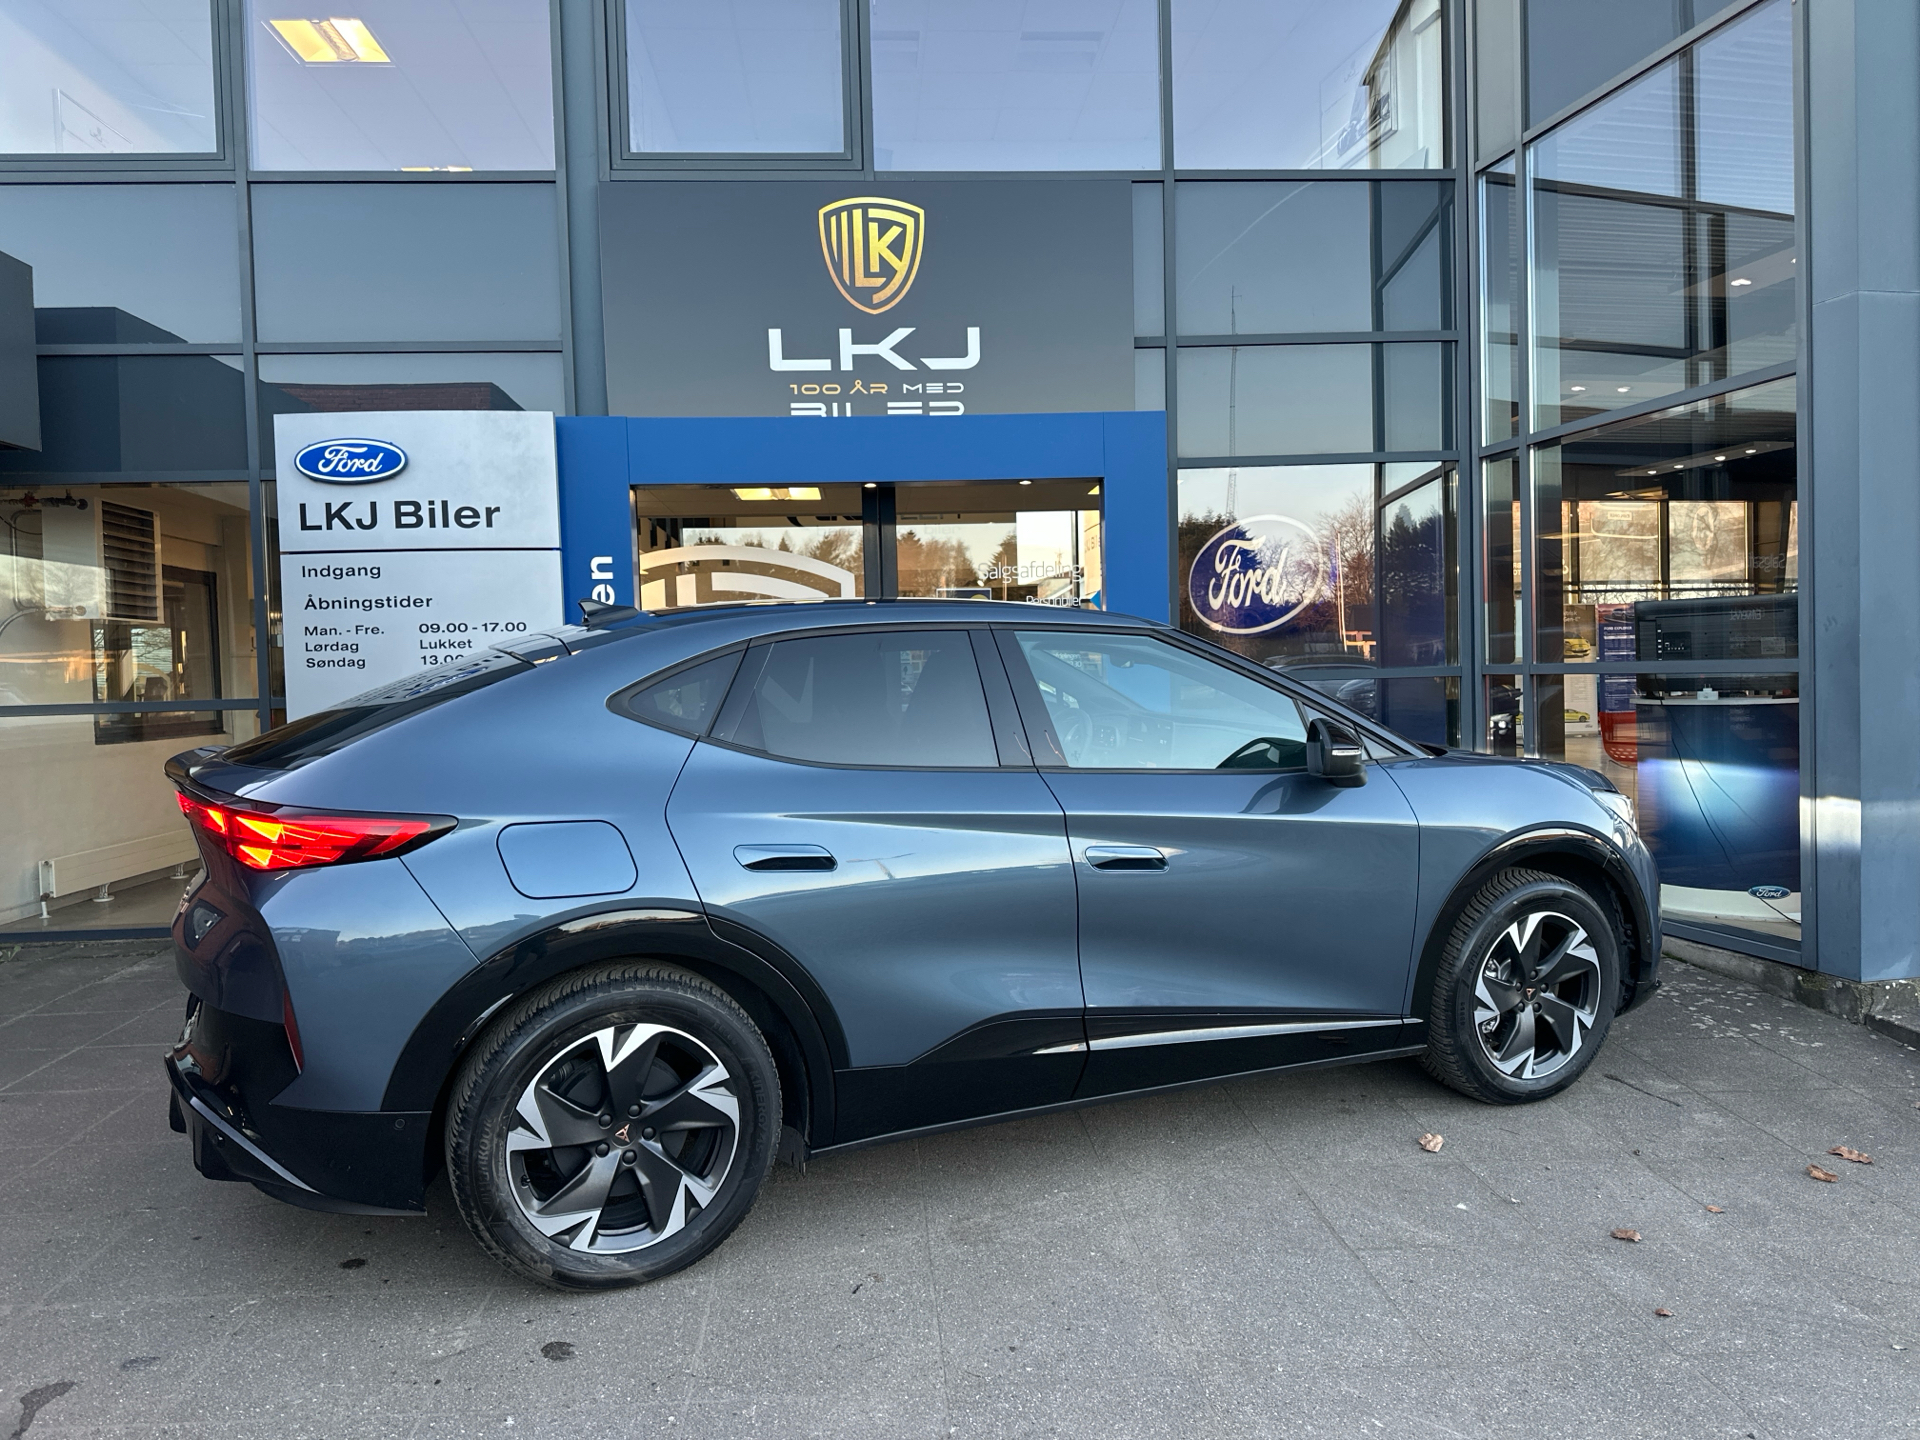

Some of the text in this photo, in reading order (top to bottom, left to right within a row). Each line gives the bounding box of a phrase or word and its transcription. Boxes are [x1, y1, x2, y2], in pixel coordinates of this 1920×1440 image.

[768, 326, 981, 372] LKJ
[789, 379, 965, 395] 100 ÅR MED
[318, 445, 384, 473] Ford
[299, 499, 501, 531] LKJ Biler
[301, 564, 381, 579] Indgang
[977, 561, 1081, 584] Salgsafdeling
[1208, 535, 1288, 611] Ford
[304, 593, 433, 612] Åbningstider
[304, 625, 342, 637] Man.
[355, 624, 385, 635] Fre.
[418, 622, 469, 634] 09.00
[481, 621, 528, 633] 17.00
[305, 638, 473, 654] Lørdag Lukket
[306, 656, 366, 670] Søndag
[1756, 889, 1783, 897] Ford
[749, 1070, 767, 1131] KINERGY
